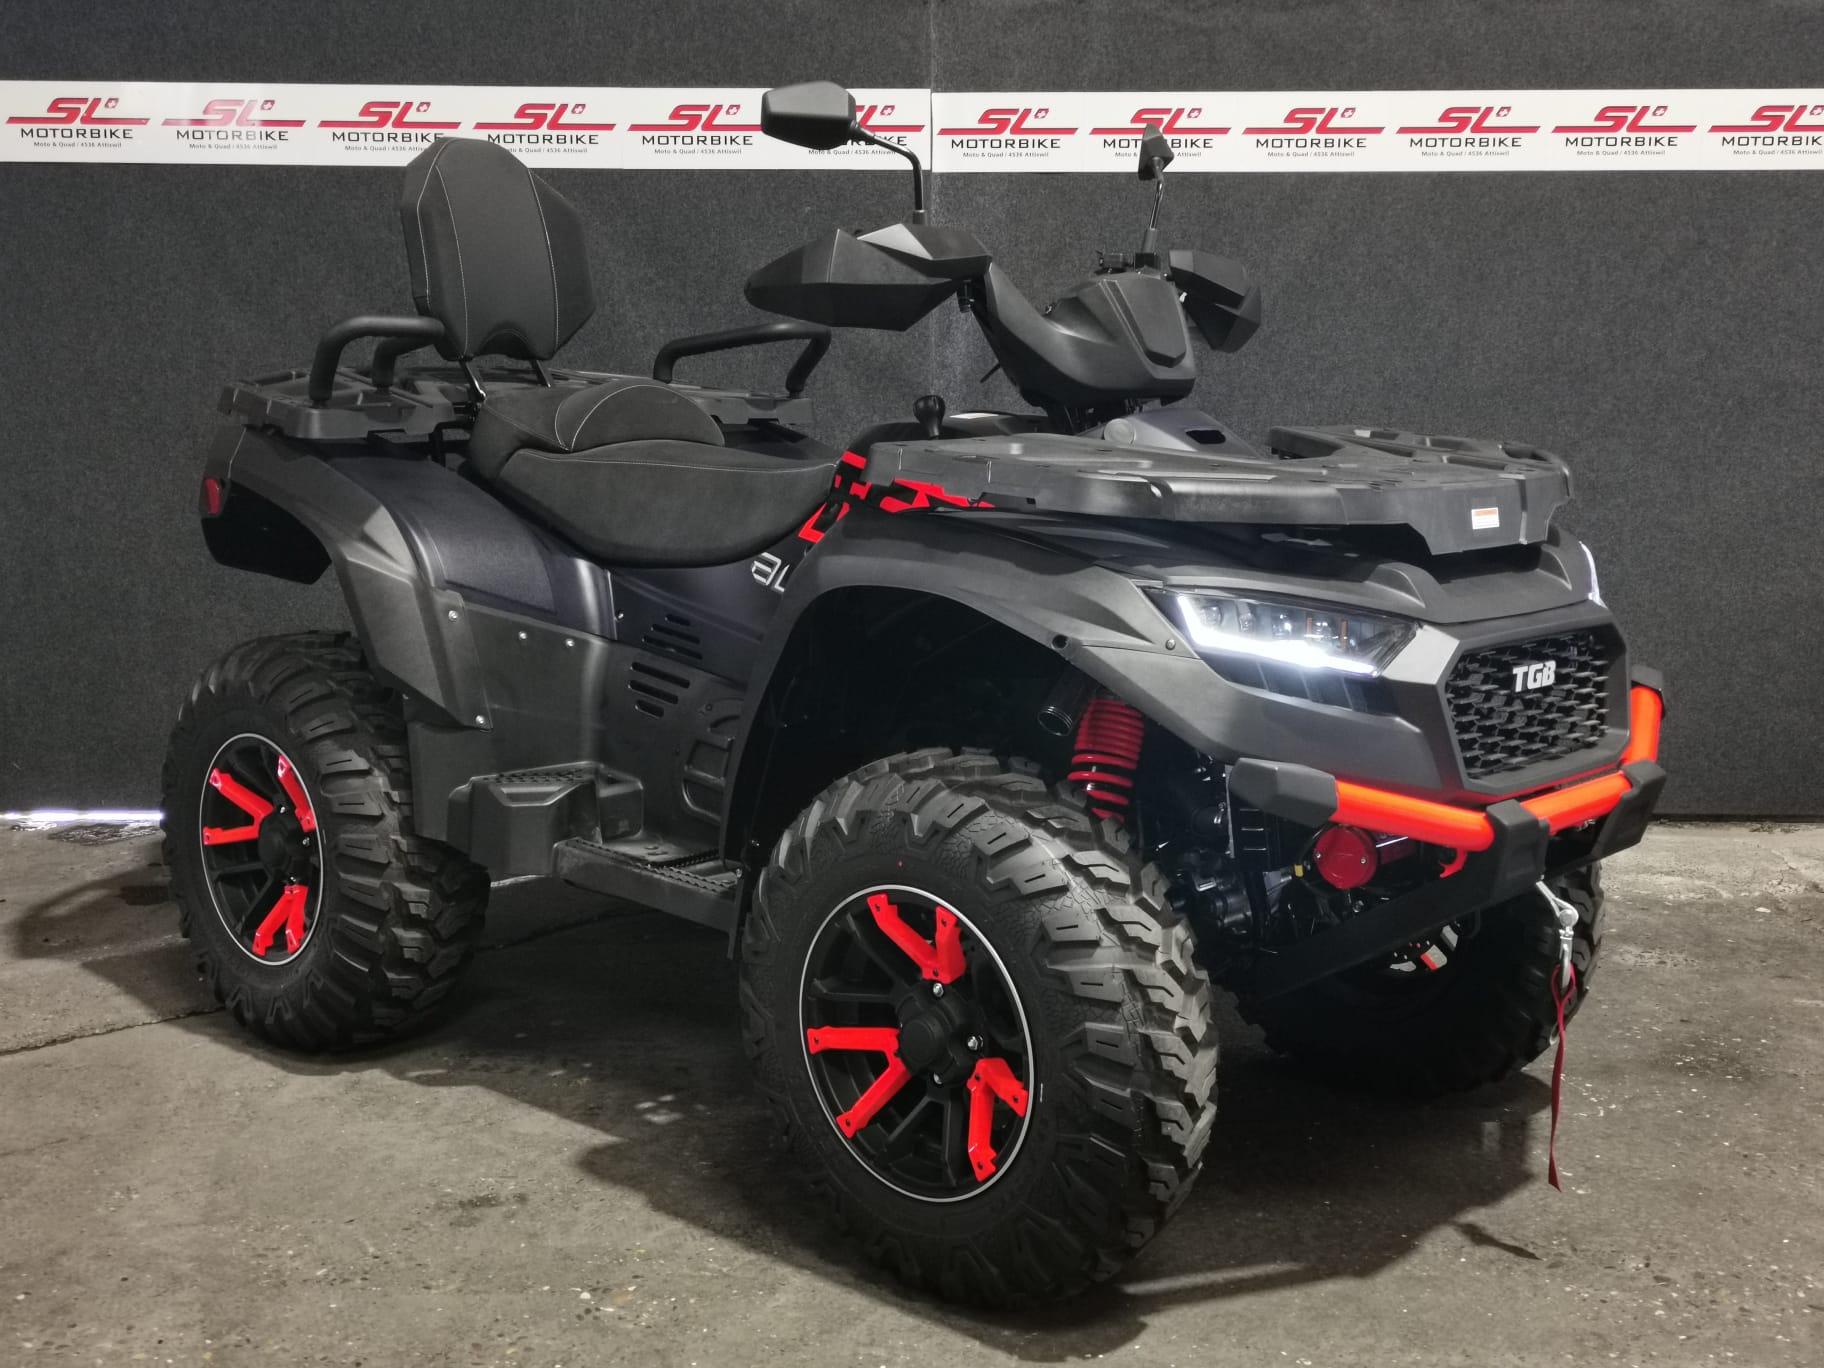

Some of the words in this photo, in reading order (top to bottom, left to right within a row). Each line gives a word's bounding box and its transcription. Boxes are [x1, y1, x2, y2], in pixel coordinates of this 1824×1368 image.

[20, 128, 132, 139] MOTORBIKE
[176, 130, 288, 141] MOTORBIKE
[488, 133, 599, 144] MOTORBIKE
[642, 135, 752, 146] MOTORBIKE
[951, 138, 1060, 149] MOTORBIKE
[1104, 138, 1213, 149] MOTBIKE
[1256, 138, 1367, 148] MOTORBIKE
[1410, 137, 1522, 148] MOTORBIKE
[1566, 136, 1678, 147] MOTORBIKE
[1722, 136, 1823, 146] MOTORBIK
[1513, 660, 1556, 692] TGB
